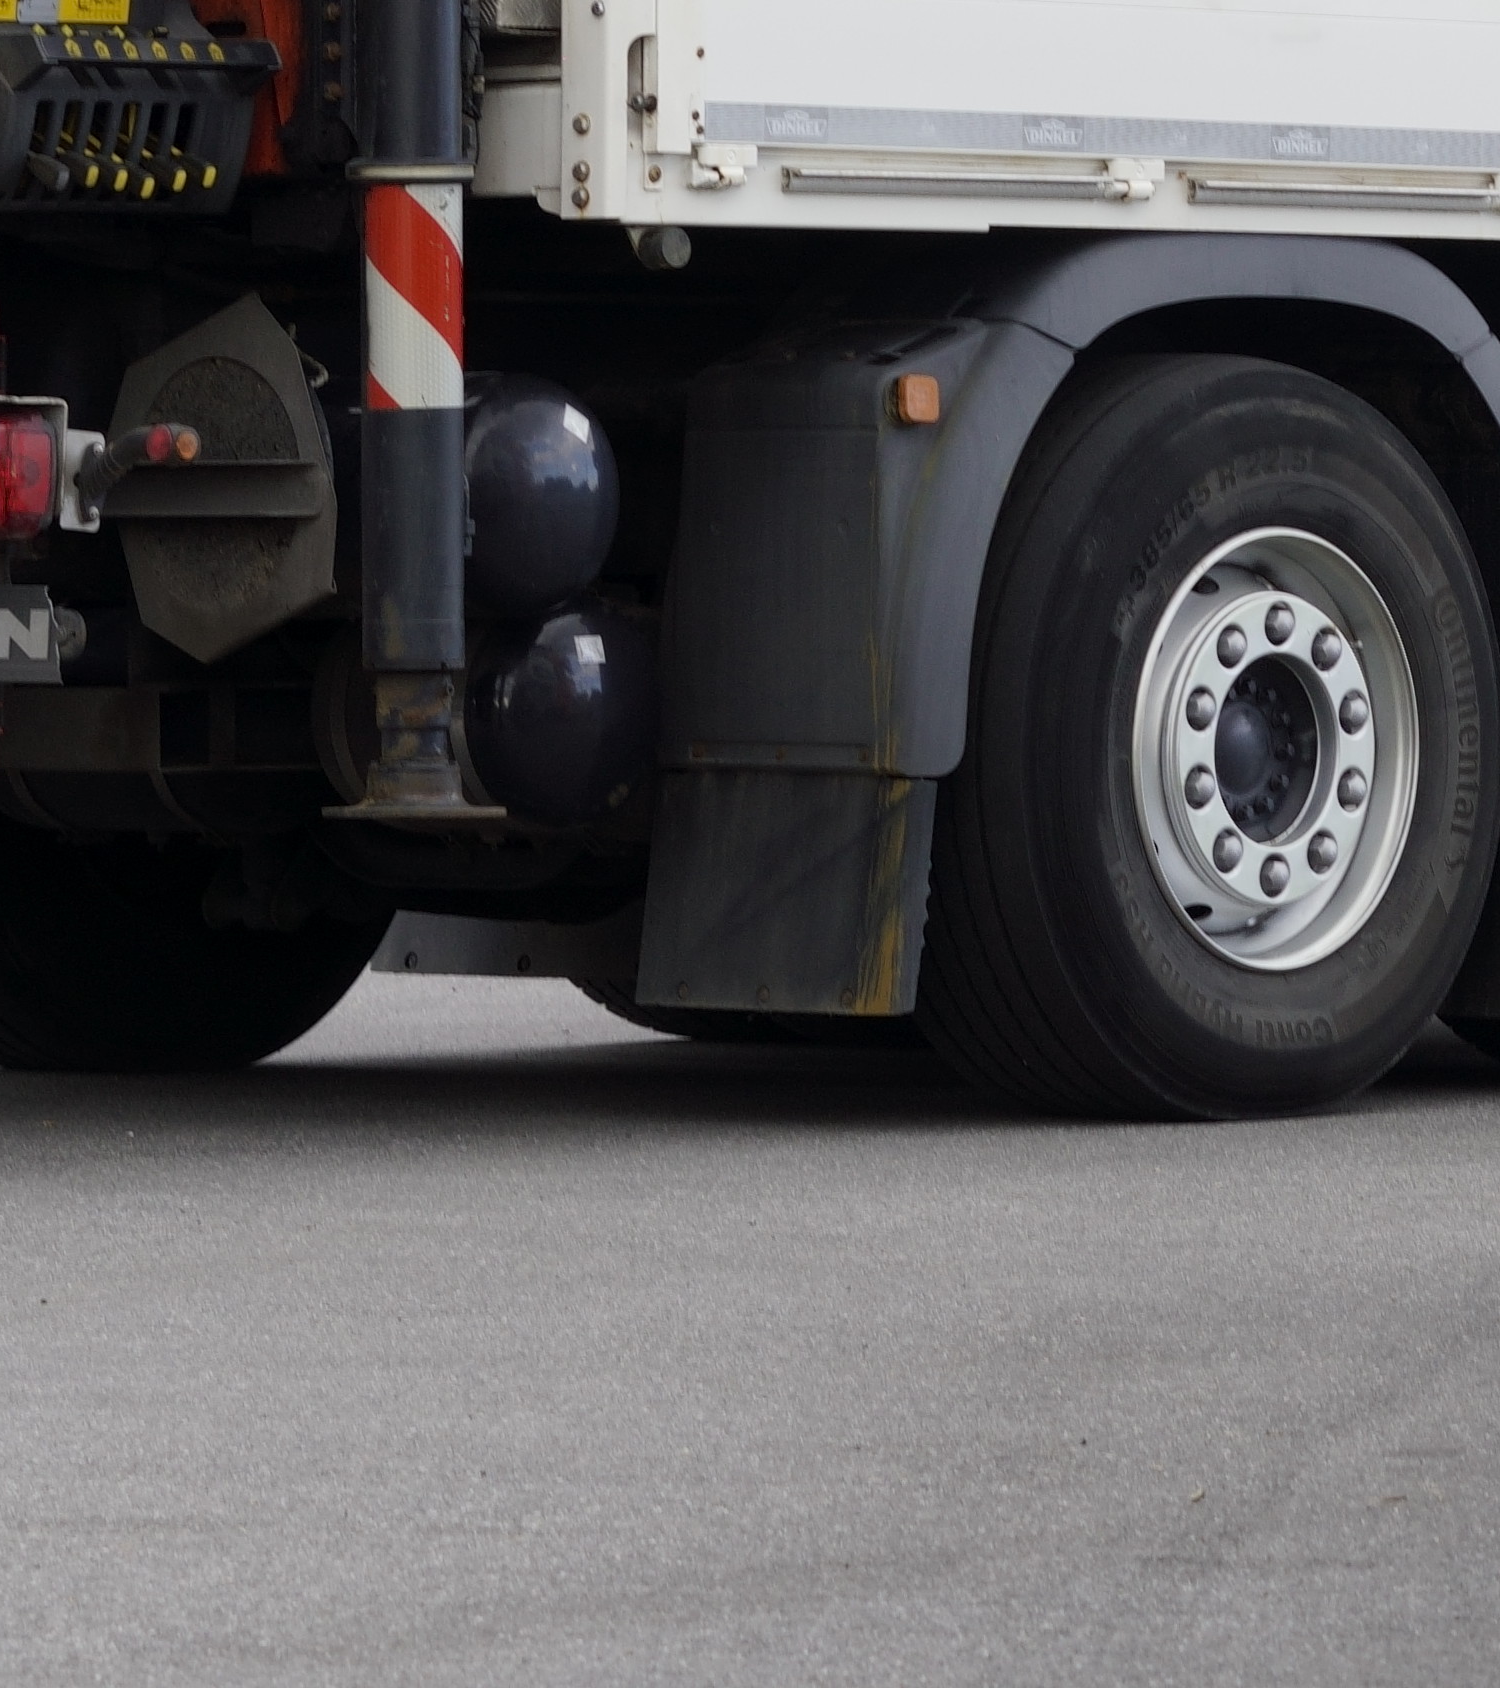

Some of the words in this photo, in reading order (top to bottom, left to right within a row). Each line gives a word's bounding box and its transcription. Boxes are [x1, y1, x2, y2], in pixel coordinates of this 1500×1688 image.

[769, 118, 823, 137] DINKEL
[1029, 128, 1080, 145] DINKEL
[1278, 137, 1325, 155] DINKEL
